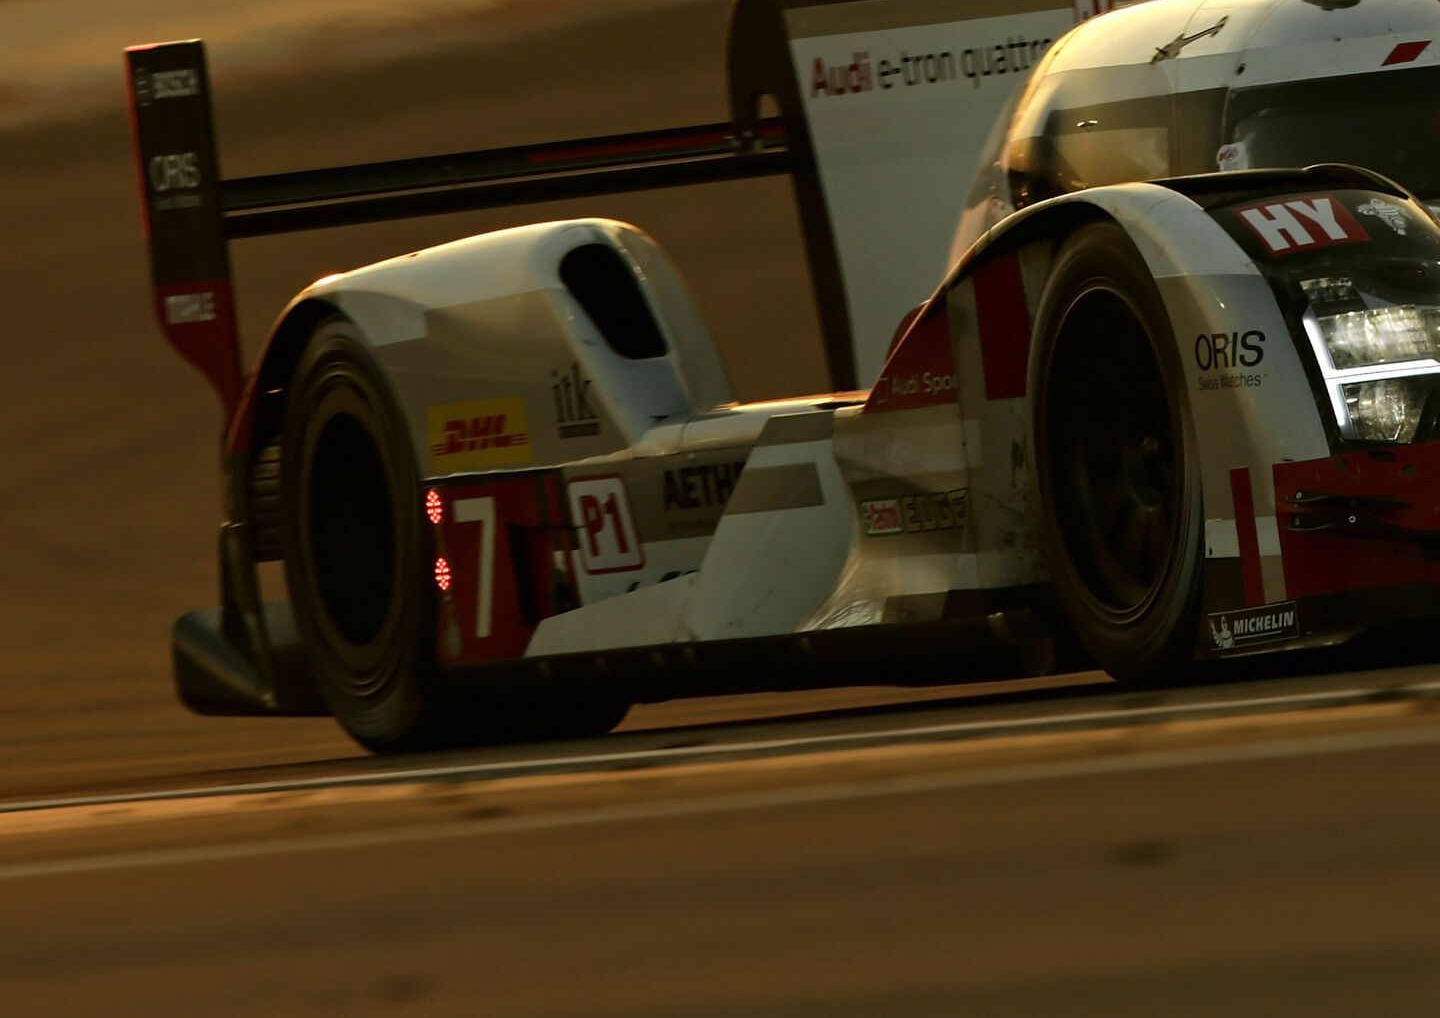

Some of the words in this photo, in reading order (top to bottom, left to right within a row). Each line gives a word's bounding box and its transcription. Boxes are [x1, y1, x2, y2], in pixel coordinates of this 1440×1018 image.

[811, 51, 873, 98] Audi
[877, 51, 957, 89] e-tron
[1240, 198, 1349, 252] HY
[1195, 330, 1266, 371] ORIS
[1219, 373, 1262, 390] Watches
[443, 413, 515, 455] DHL
[580, 492, 629, 557] P1
[452, 496, 496, 639] 7
[1234, 610, 1295, 636] MICHELIN
